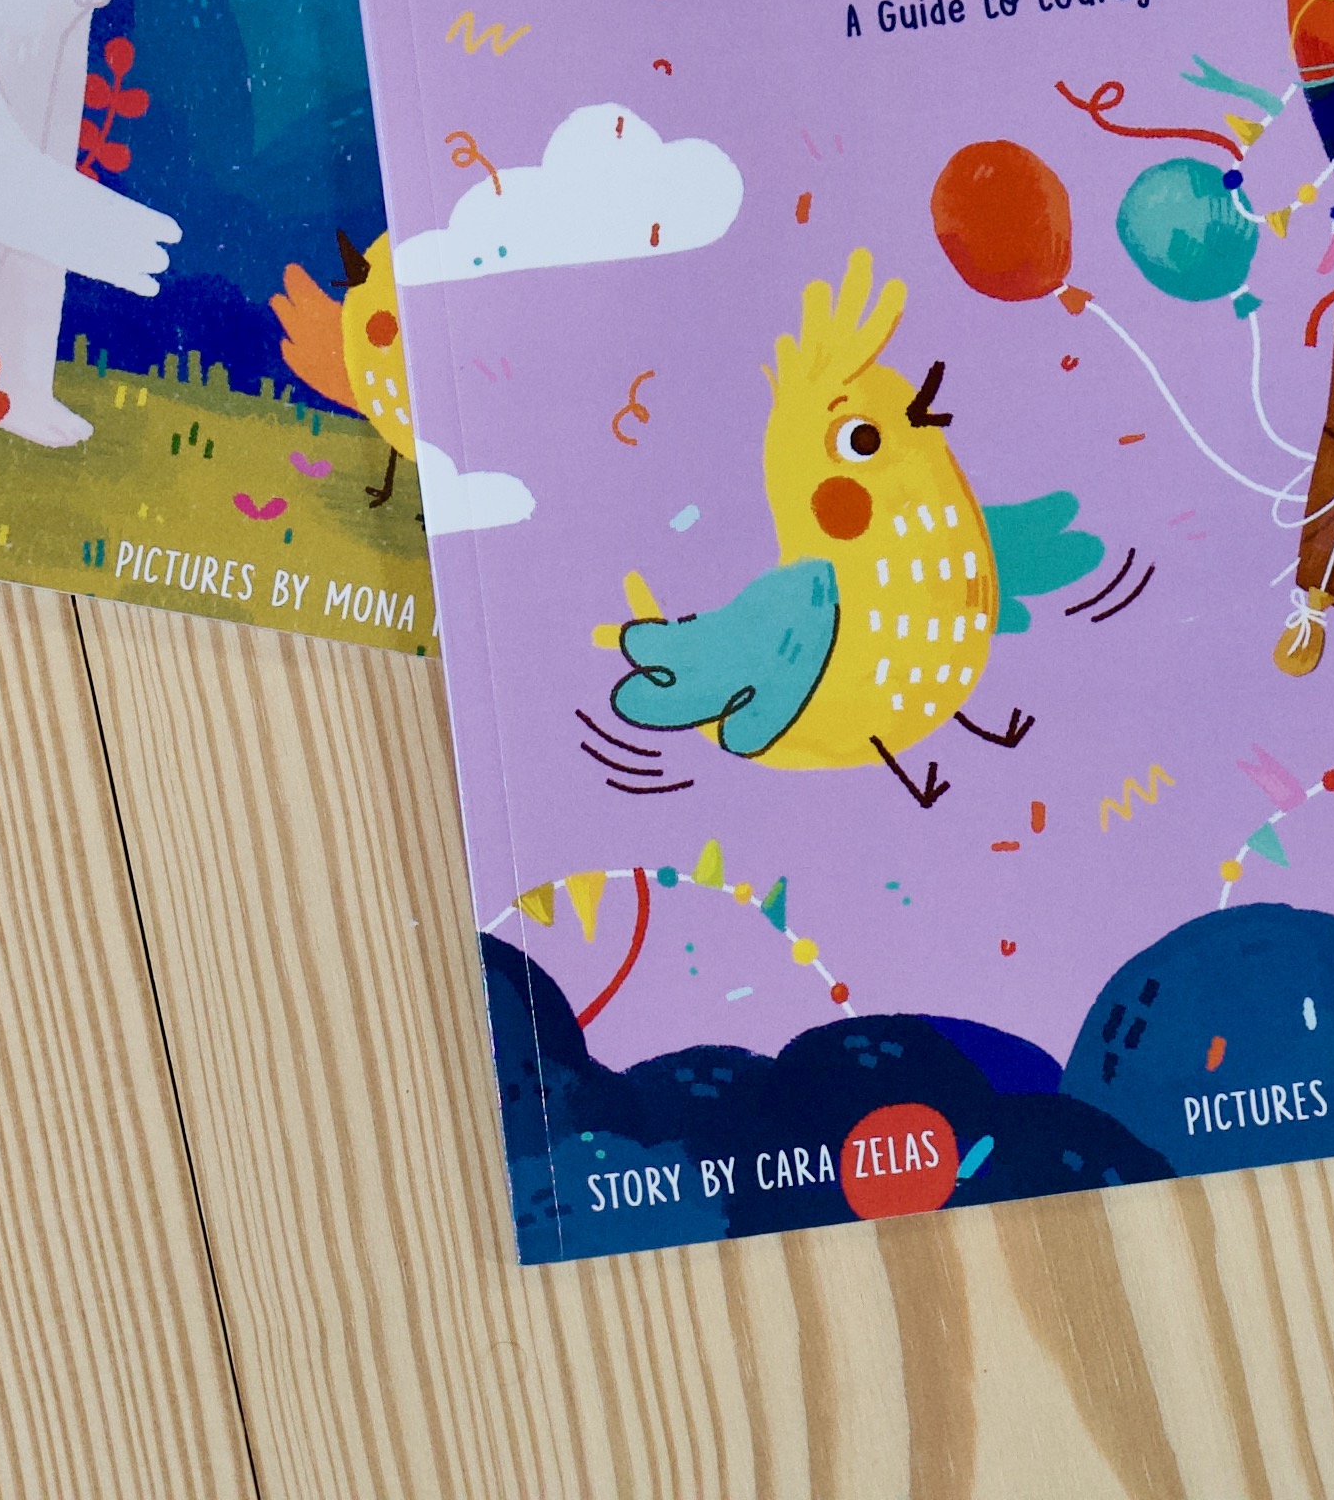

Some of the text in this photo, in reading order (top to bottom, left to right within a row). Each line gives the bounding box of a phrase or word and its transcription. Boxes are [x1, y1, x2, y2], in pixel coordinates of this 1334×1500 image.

[847, 4, 861, 37] A
[116, 541, 254, 600] PICTURES
[272, 570, 309, 610] BY
[324, 581, 414, 631] MONA
[1184, 1080, 1327, 1135] PICTURES
[588, 1130, 938, 1211] STORY BY CARA ZELAS
